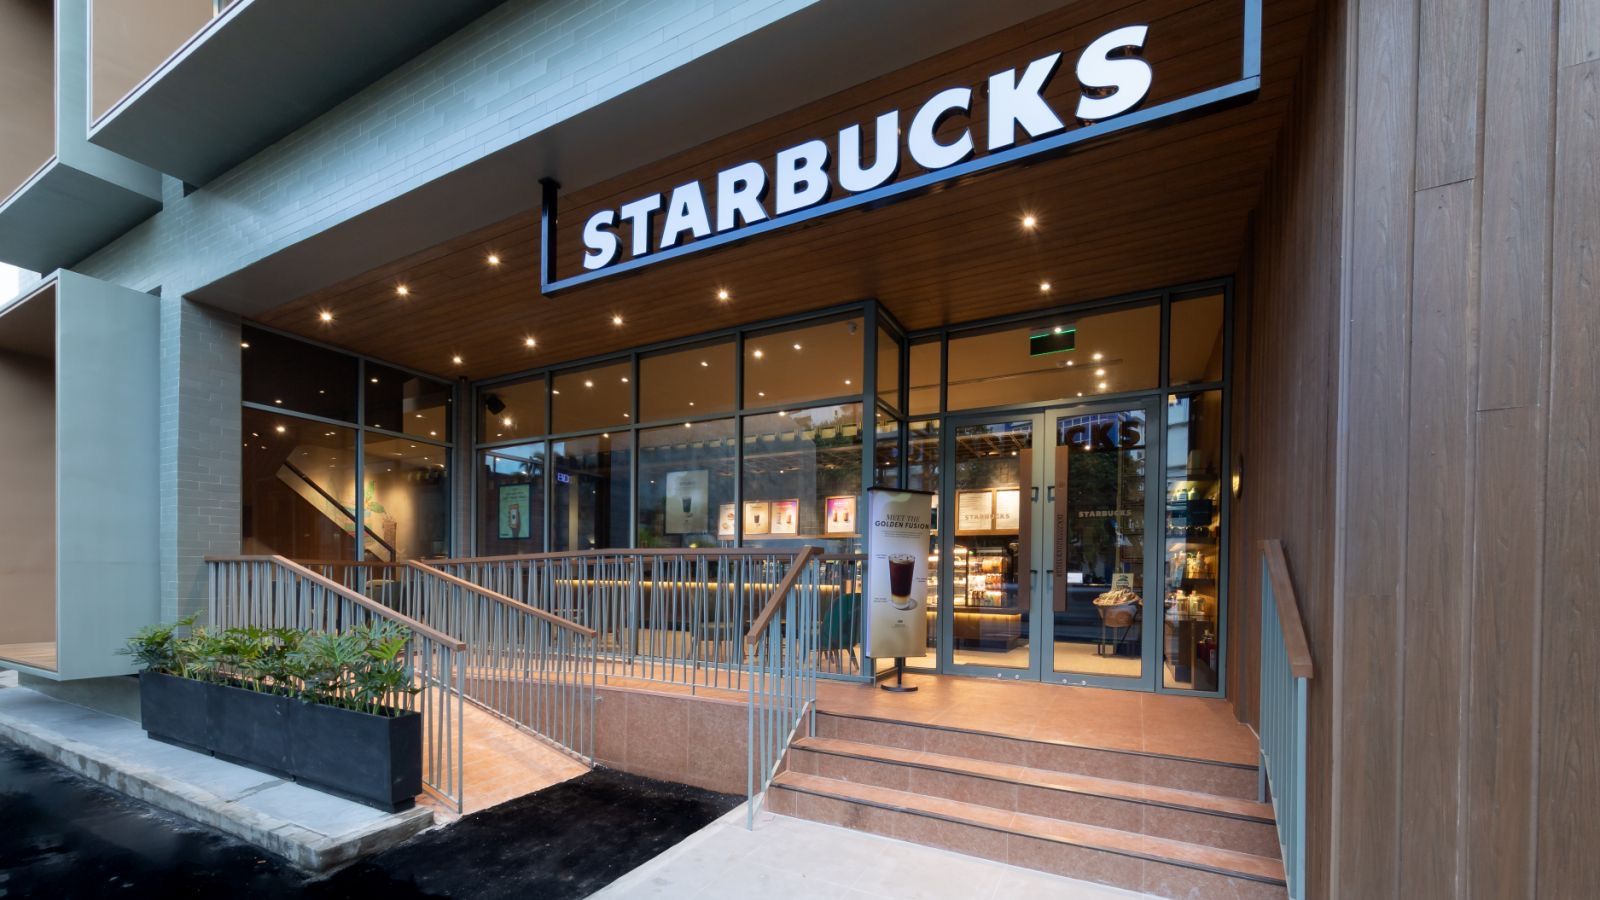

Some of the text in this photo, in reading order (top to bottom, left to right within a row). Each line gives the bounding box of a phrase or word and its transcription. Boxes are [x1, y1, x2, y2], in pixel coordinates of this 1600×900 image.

[582, 24, 1154, 271] STARBUCKS
[886, 513, 905, 522] MEET
[964, 512, 1010, 521] STARBUCKS
[1078, 509, 1132, 518] STARBUCKS
[874, 520, 930, 530] GOLDEN FUSION
